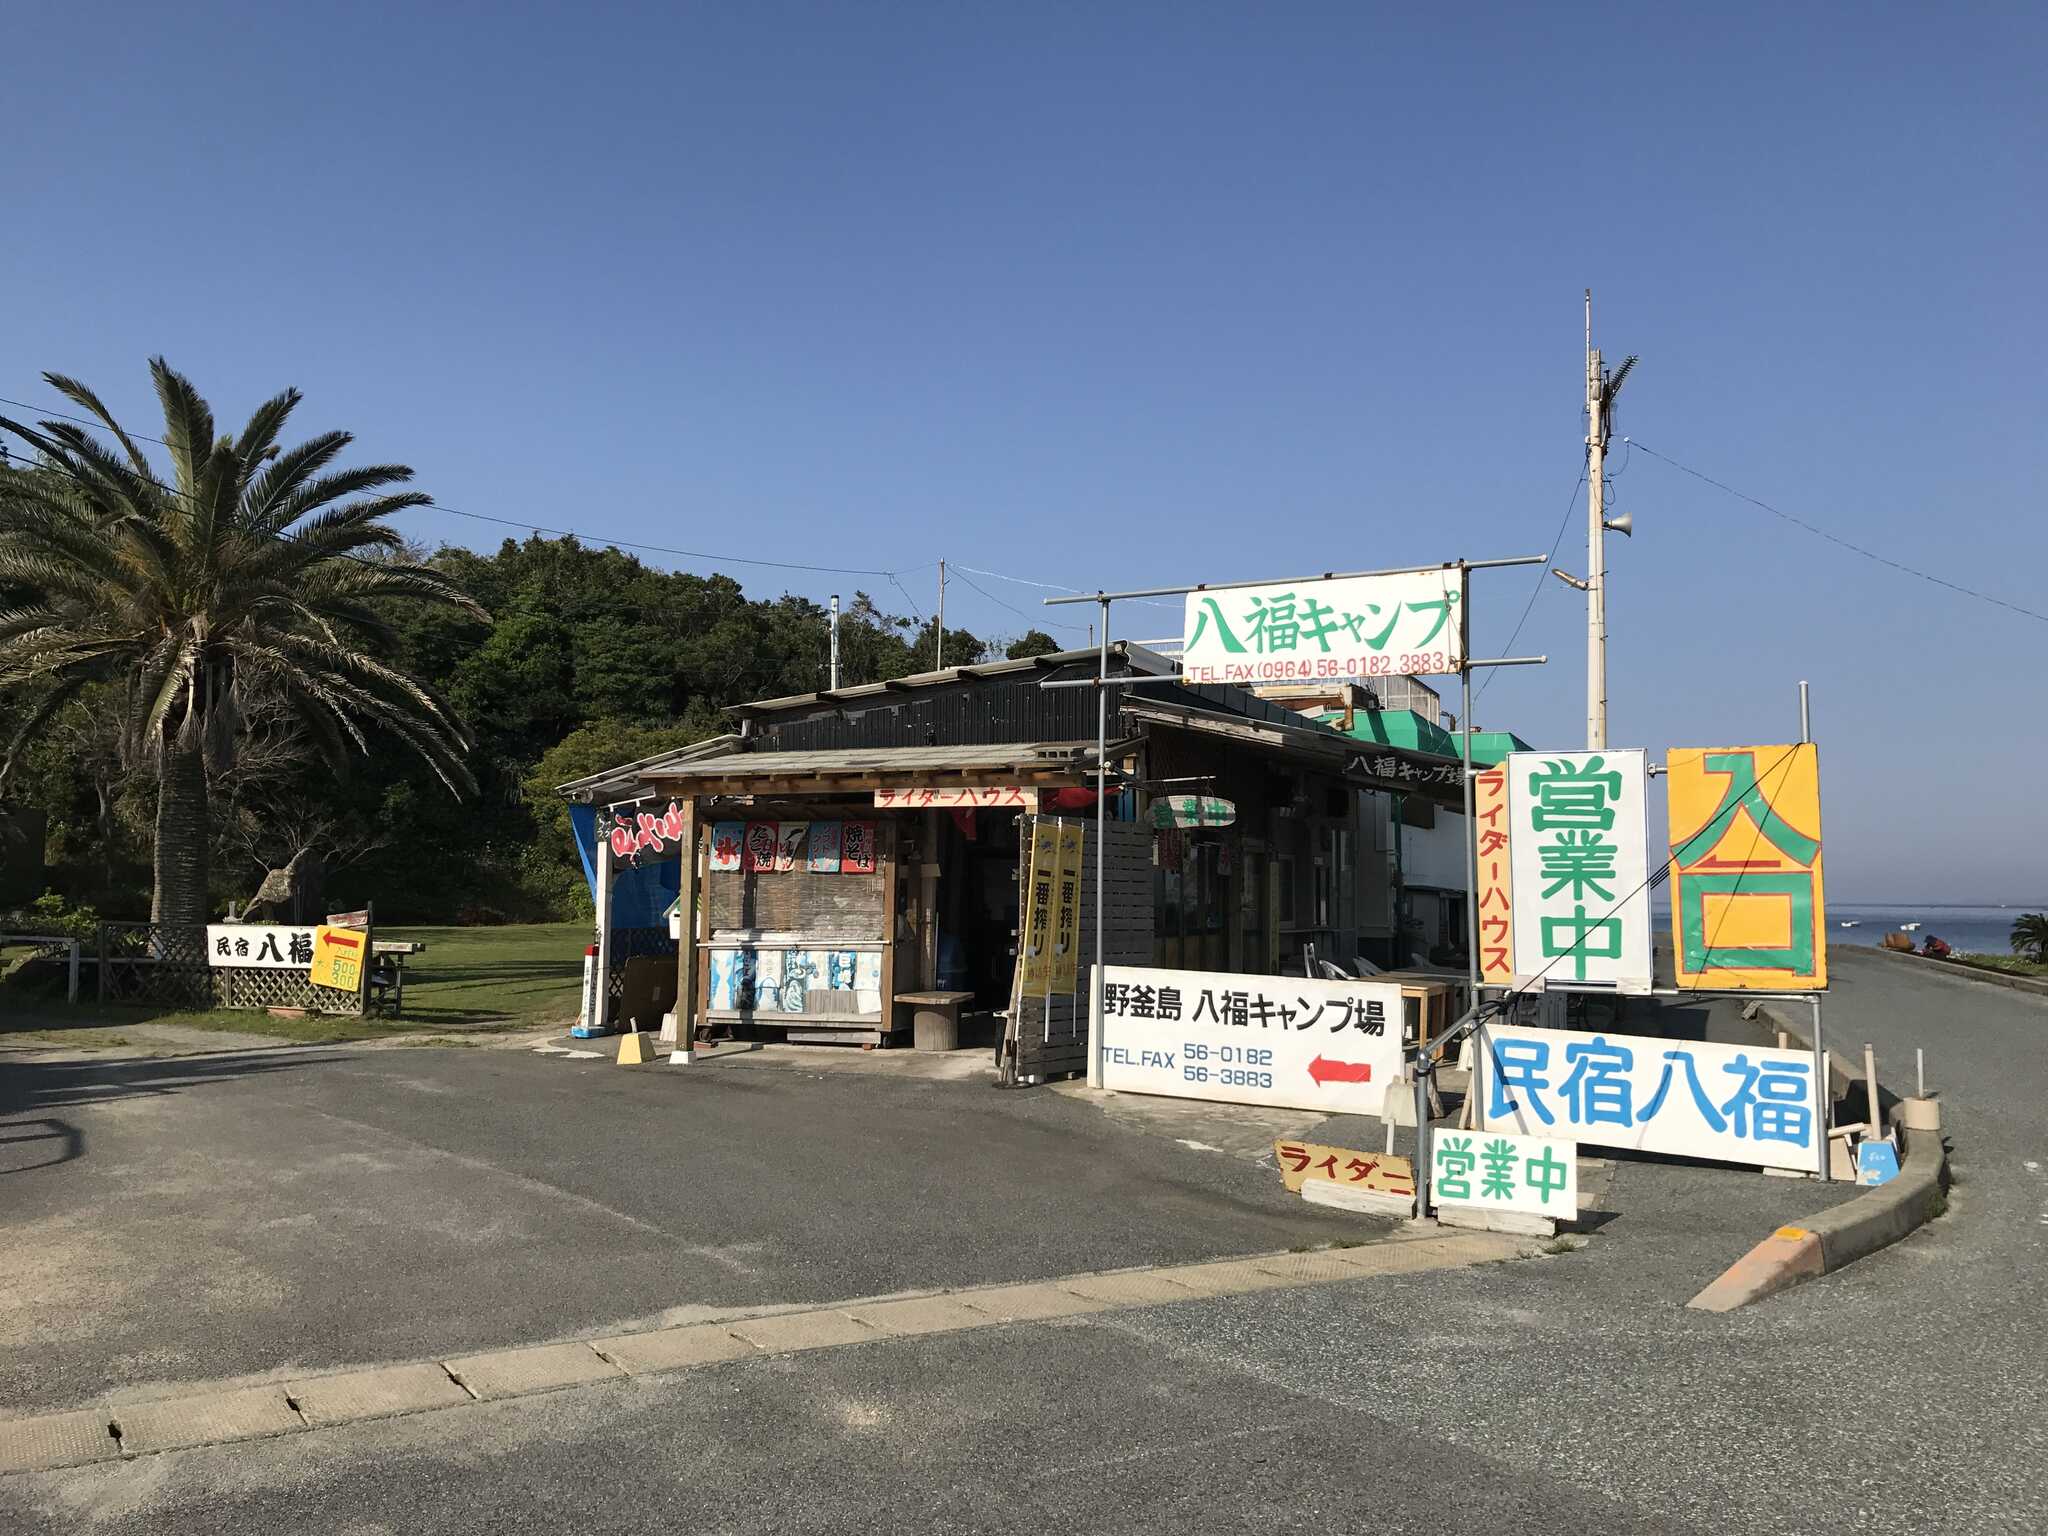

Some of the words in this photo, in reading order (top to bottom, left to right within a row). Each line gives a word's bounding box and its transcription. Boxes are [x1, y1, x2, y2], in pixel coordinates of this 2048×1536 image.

[1184, 590, 1461, 654] 八福キャンプ
[879, 786, 1026, 807] ライダーハウス
[1342, 755, 1466, 787] 八福キャンプ場
[715, 836, 740, 865] 氷
[845, 825, 869, 868] 焼そば
[1477, 770, 1511, 974] ライダーハウス
[1528, 755, 1623, 981] 営業中
[1669, 751, 1822, 976] 入口
[1033, 869, 1051, 956] 一番搾り
[1059, 869, 1076, 955] 一番搾り
[1103, 983, 1182, 1021] 野釜島
[1192, 989, 1385, 1037] 八福キャンプ場
[1184, 1043, 1273, 1066] 56-0182
[1184, 1066, 1273, 1088] 56-3883
[1489, 1036, 1812, 1149] 民宿八福
[1280, 1145, 1411, 1182] ライダー
[1436, 1136, 1567, 1204] 営業中
